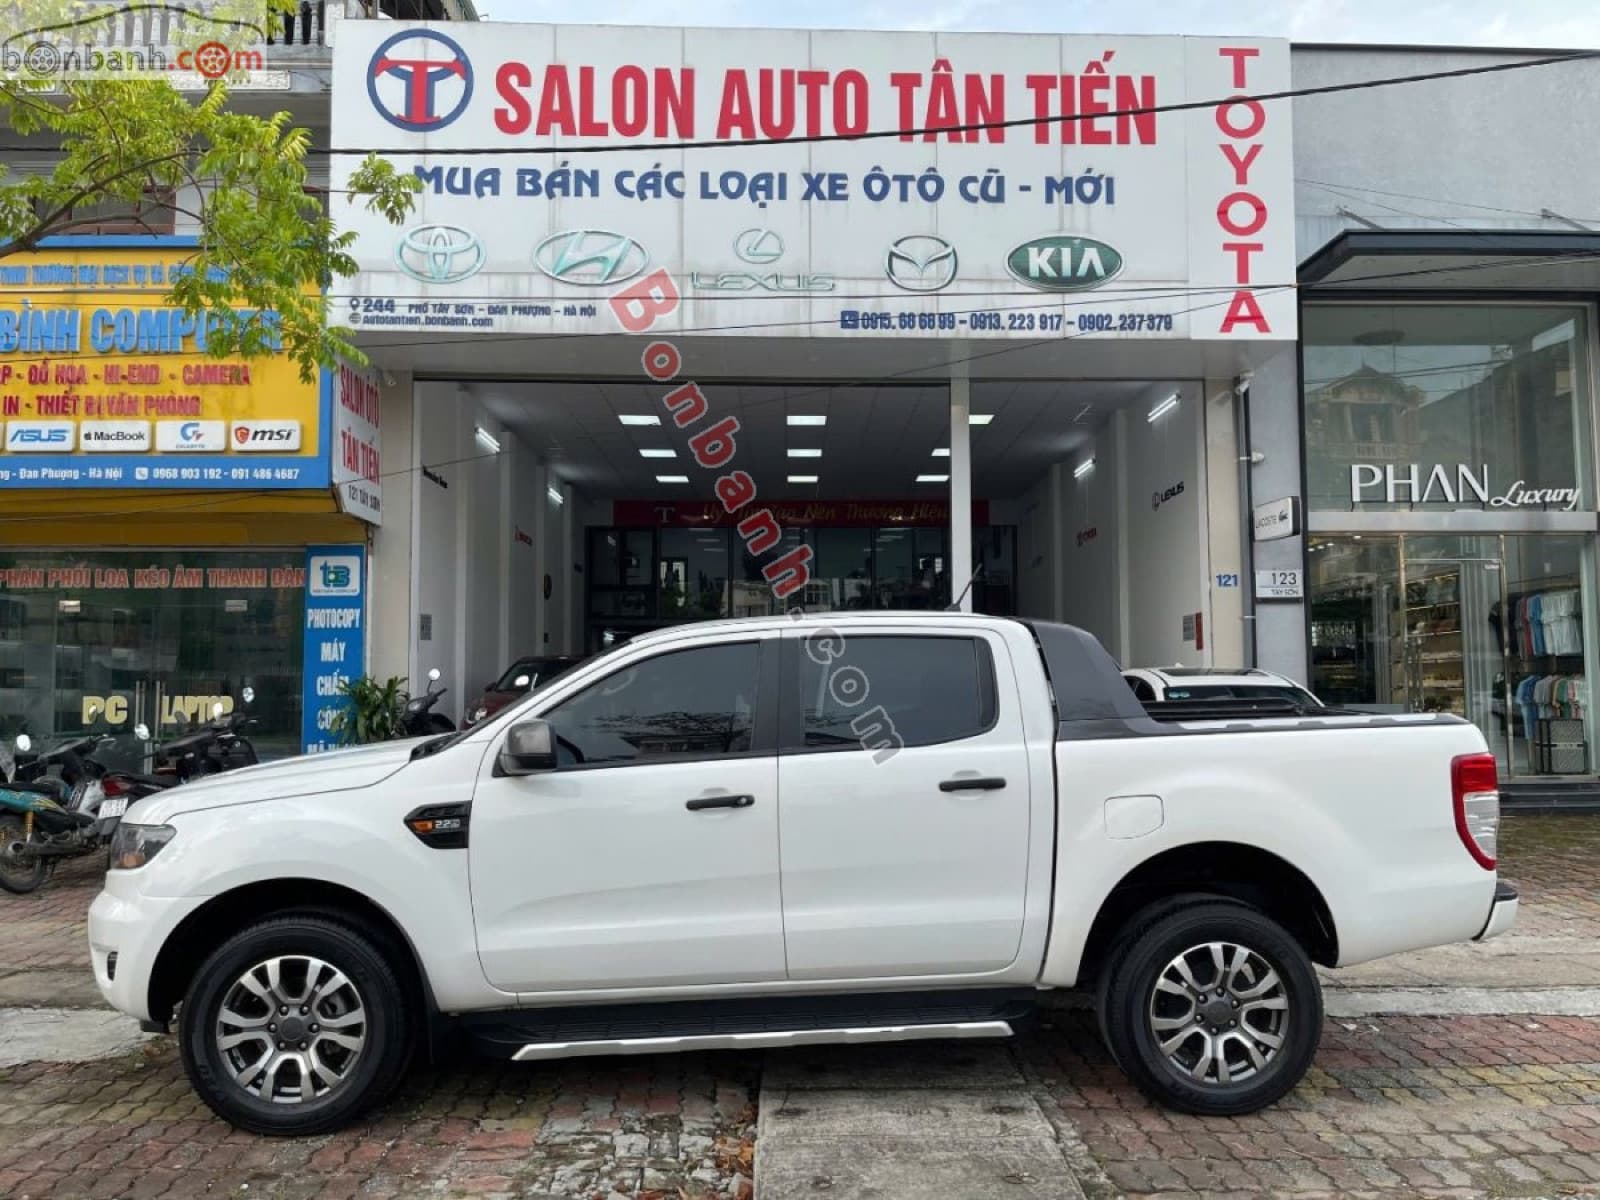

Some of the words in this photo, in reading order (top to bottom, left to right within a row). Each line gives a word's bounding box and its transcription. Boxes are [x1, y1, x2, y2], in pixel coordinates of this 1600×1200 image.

[494, 62, 695, 139] SALON
[716, 68, 869, 141] AUTO
[890, 59, 1006, 143] TÂN
[1026, 51, 1157, 145] TIẾN
[414, 165, 500, 198] MUA
[516, 161, 600, 199] BÁN
[614, 162, 686, 201] CÁC
[700, 171, 787, 208] LOẠI
[800, 172, 848, 201] XE
[863, 165, 945, 203] ÔTÔ
[958, 169, 1006, 204] CŨ
[1045, 168, 1115, 206] MỚI
[1216, 47, 1271, 333] TOYOTA
[1028, 247, 1106, 278] KIA
[690, 271, 836, 292] LEXUS
[363, 298, 395, 313] 244
[0, 299, 80, 351] BÌNH
[1008, 312, 1034, 331] 223
[1039, 312, 1064, 331] 917
[104, 364, 160, 385] HI-END
[183, 364, 250, 385] CAMERA
[10, 430, 69, 442] ASUS
[93, 431, 145, 442] MacBook
[1351, 464, 1489, 503] PHAN
[1490, 480, 1581, 511] Luxury
[95, 568, 129, 588] LOA
[173, 564, 203, 588] ÂM
[208, 568, 267, 588] THANH
[1216, 574, 1238, 588] 121
[1271, 572, 1297, 585] 123
[307, 608, 360, 629] PHOTOCOPY
[320, 637, 345, 662] MÁY
[82, 695, 128, 725] PC
